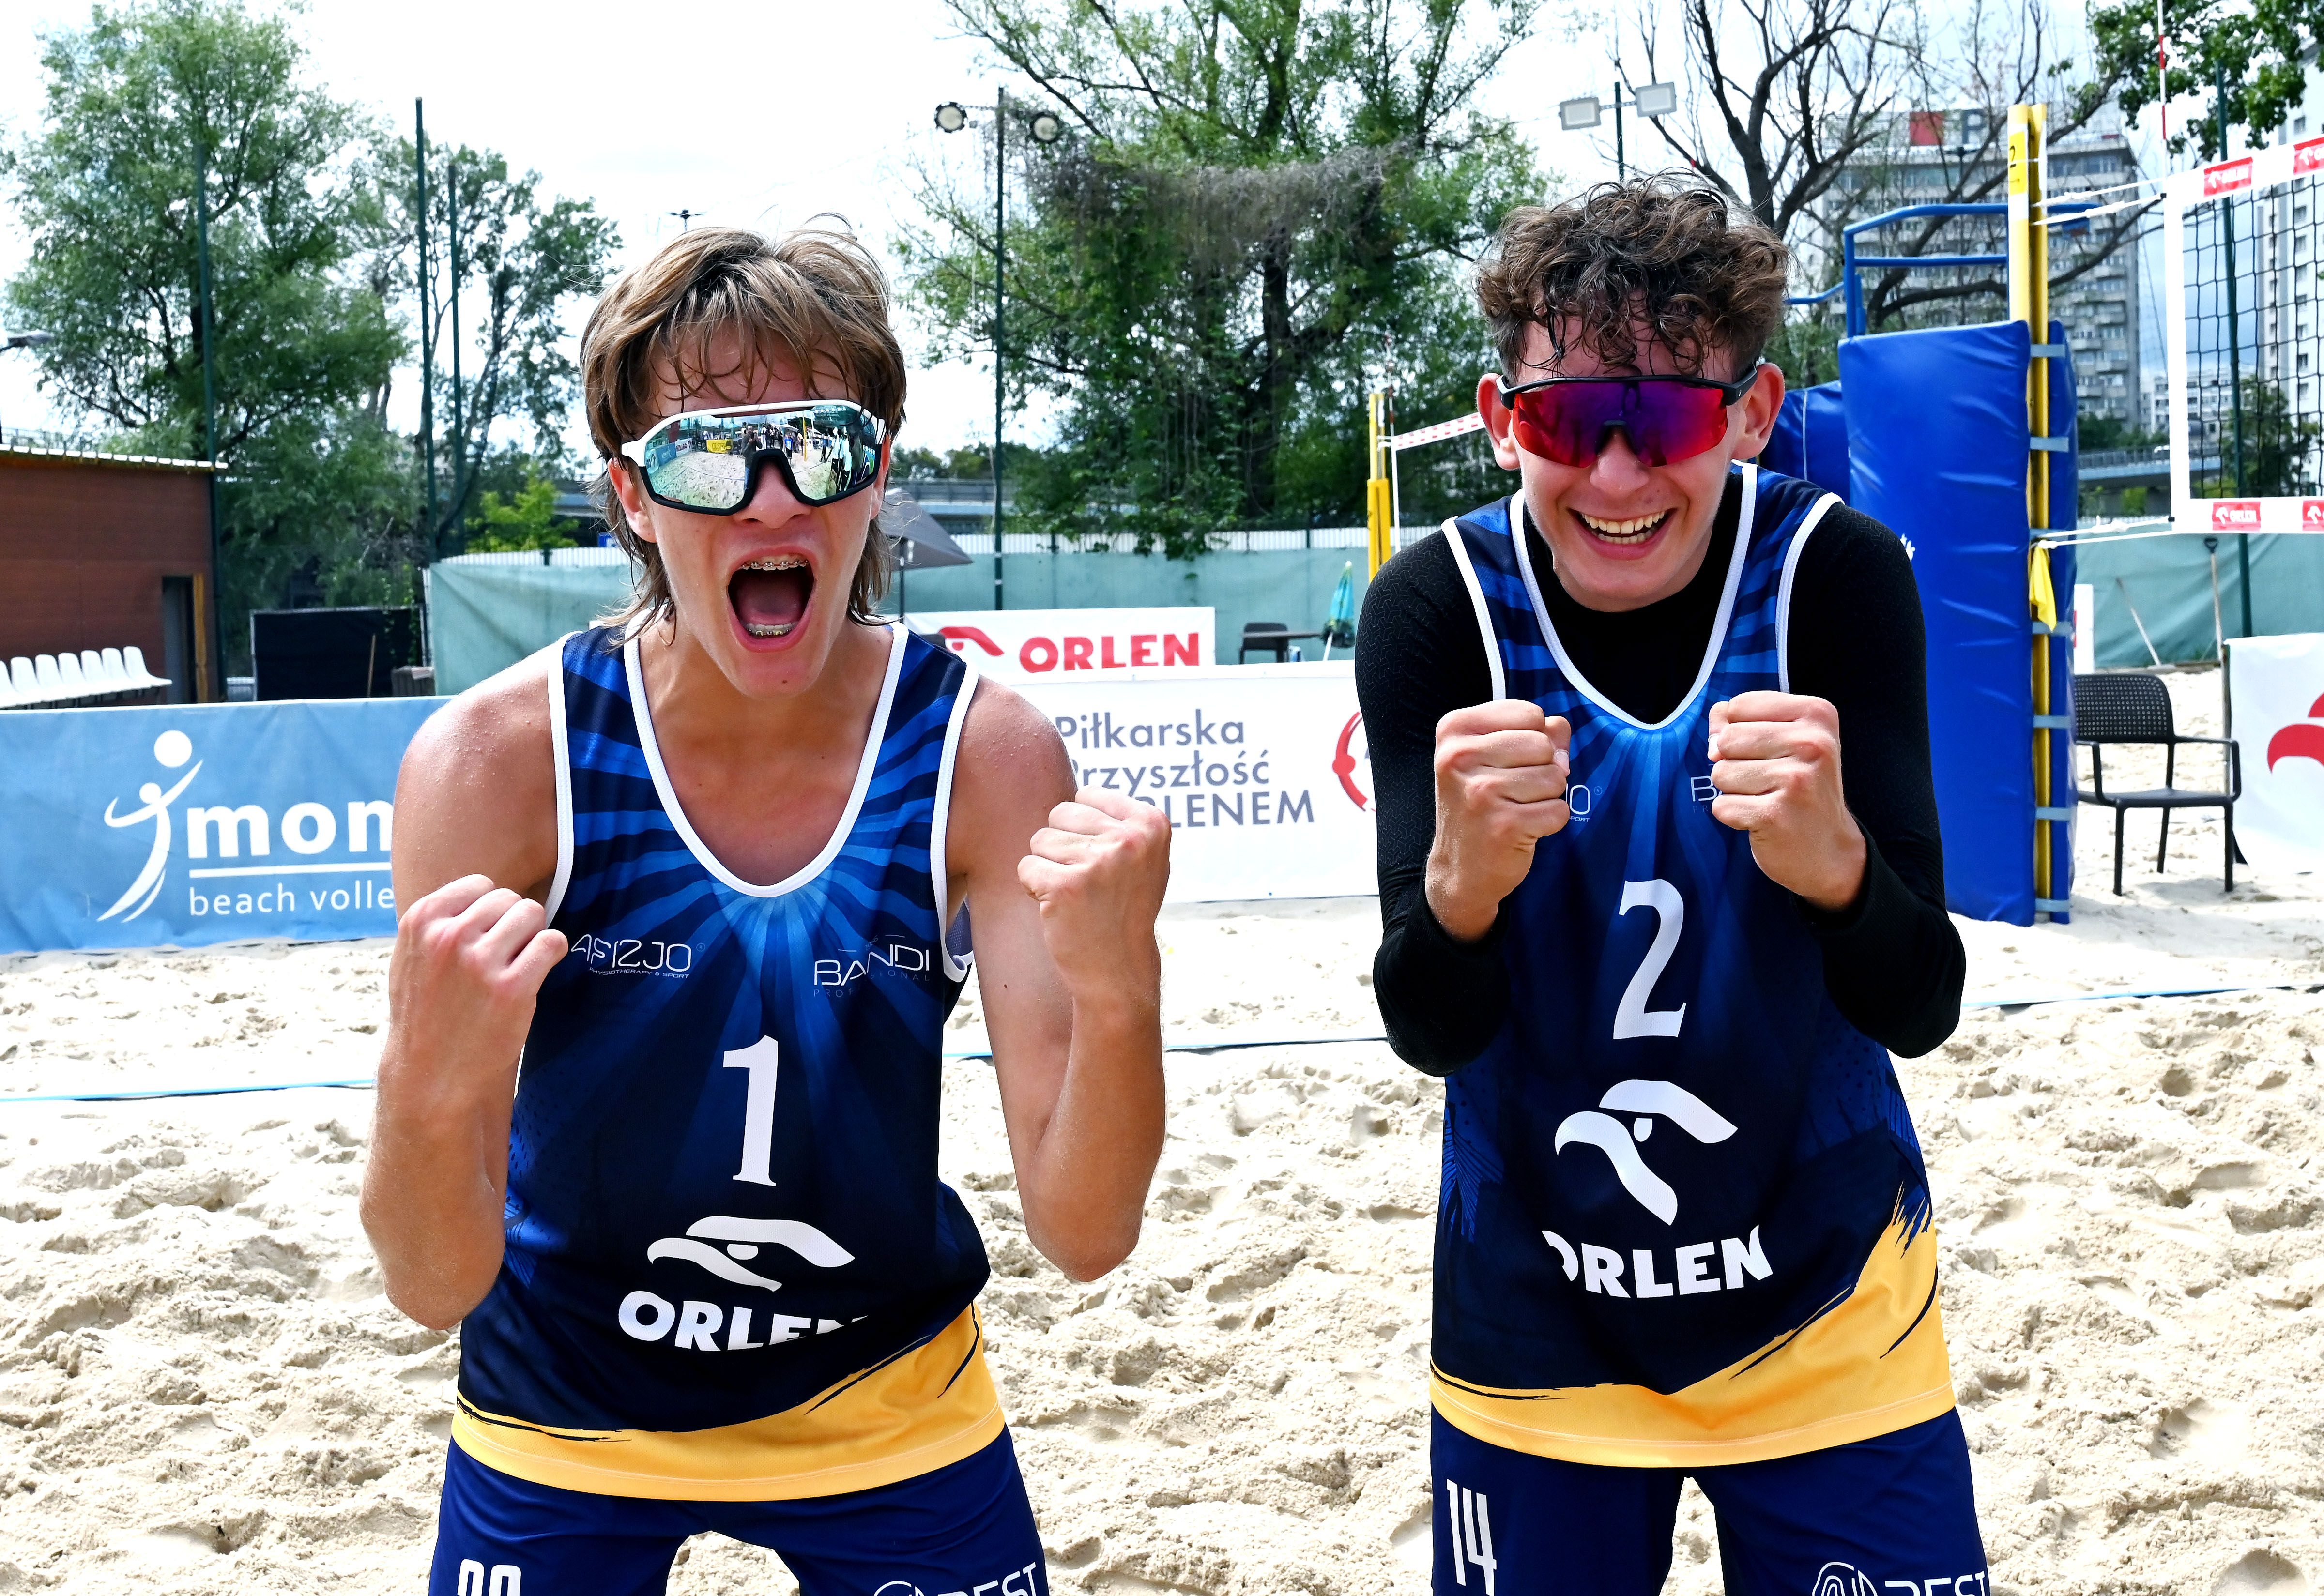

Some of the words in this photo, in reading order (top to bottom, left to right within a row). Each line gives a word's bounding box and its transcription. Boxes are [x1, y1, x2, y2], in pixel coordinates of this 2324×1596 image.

[1019, 632, 1200, 673] ORLEN
[1055, 708, 1244, 749] Piłkarska
[1071, 749, 1269, 797] rzyszłość
[1135, 790, 1314, 828] LENEM
[189, 882, 295, 916] beach
[311, 880, 394, 911] volle
[589, 967, 652, 976] PHYSIOTHERAPY
[814, 944, 929, 986] BANDI
[1613, 879, 1686, 1040] 2
[814, 970, 930, 998] PROFSIONAL
[723, 1034, 779, 1187] 1
[1446, 1479, 1497, 1596] 14
